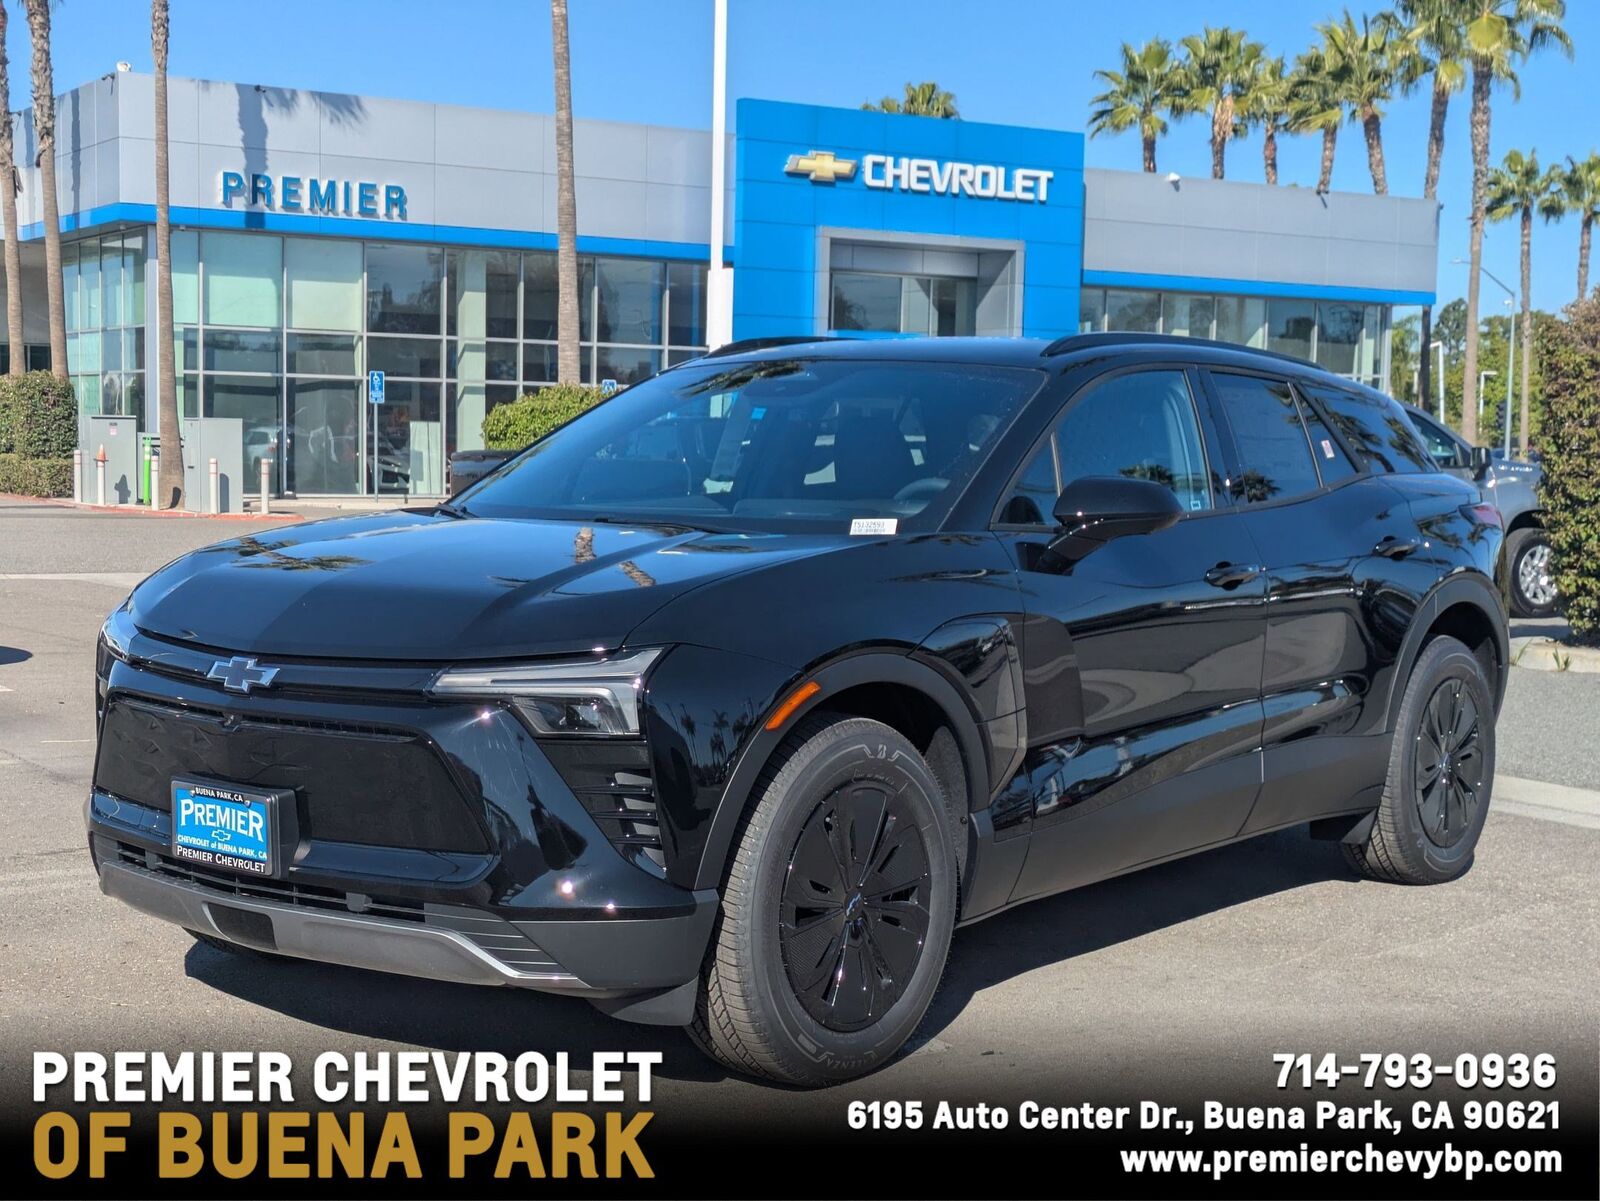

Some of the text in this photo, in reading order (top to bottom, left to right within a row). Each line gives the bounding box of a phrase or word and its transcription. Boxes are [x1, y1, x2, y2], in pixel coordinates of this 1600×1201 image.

[221, 171, 406, 219] PREMIER
[863, 154, 1054, 202] CHEVROLET
[195, 787, 216, 798] BUENA
[180, 799, 264, 842] PREMIER
[177, 834, 210, 847] CHEVROLET
[218, 842, 238, 854] BUENA
[258, 851, 268, 859] CA
[177, 846, 265, 873] PREMIER CHEVROLET
